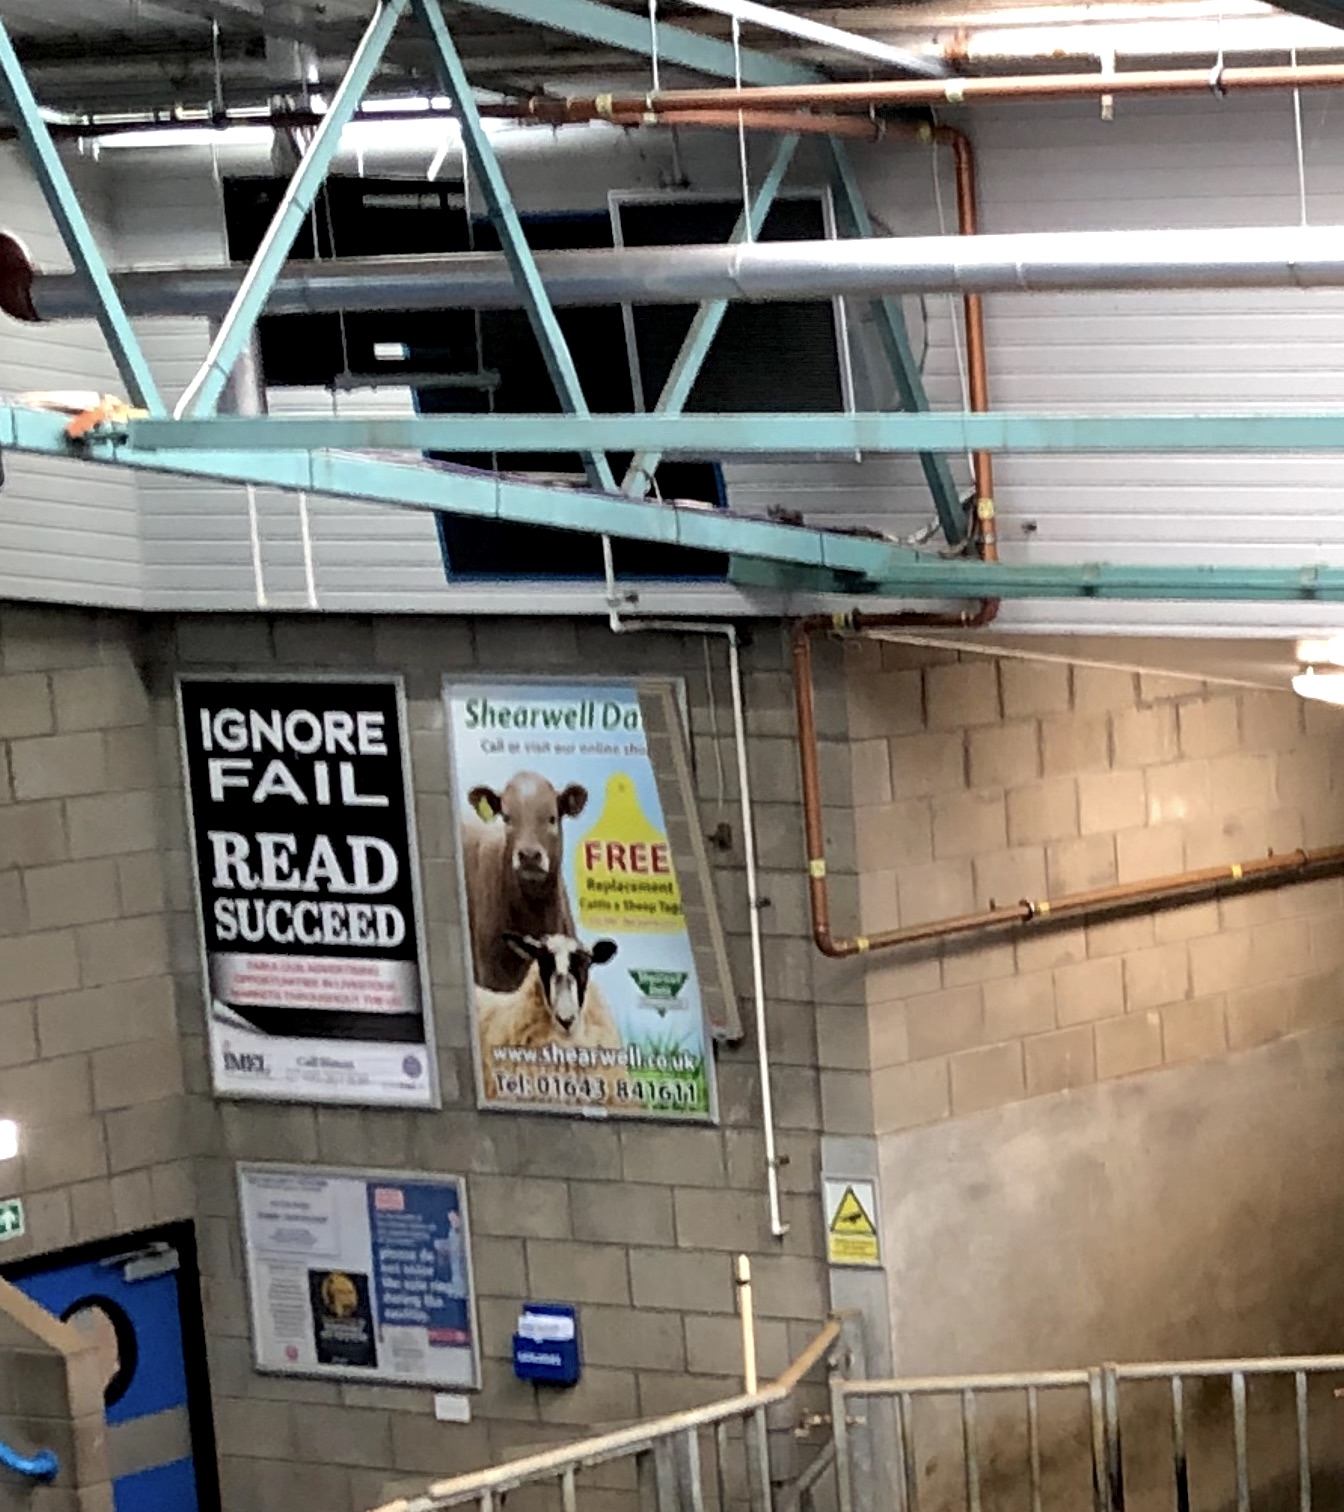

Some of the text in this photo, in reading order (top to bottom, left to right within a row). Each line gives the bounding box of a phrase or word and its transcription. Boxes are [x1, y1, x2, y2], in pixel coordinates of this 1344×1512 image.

[465, 698, 595, 730] Shearwell
[200, 708, 388, 756] IGNORE
[208, 758, 389, 807] FAIL
[207, 830, 399, 894] READ
[585, 840, 670, 874] FREE
[586, 878, 673, 895] Replacement
[214, 897, 405, 947] SUCCEED
[493, 1043, 696, 1071] www.shearwell.co.uk
[496, 1074, 531, 1093] Tel:
[537, 1076, 605, 1099] 01643
